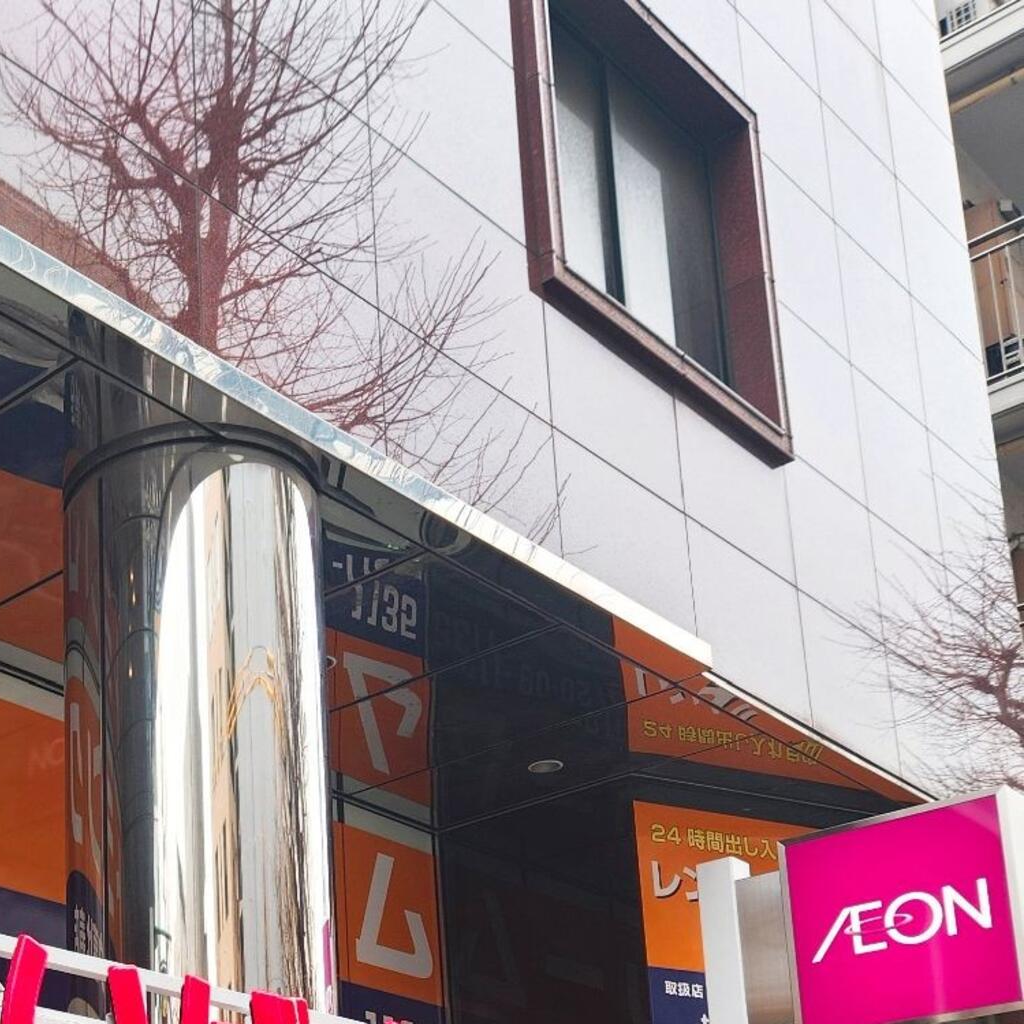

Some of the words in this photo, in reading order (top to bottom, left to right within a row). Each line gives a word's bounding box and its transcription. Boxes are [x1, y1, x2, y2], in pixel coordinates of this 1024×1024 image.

[649, 823, 682, 846] 24
[664, 980, 704, 998] 取扱店
